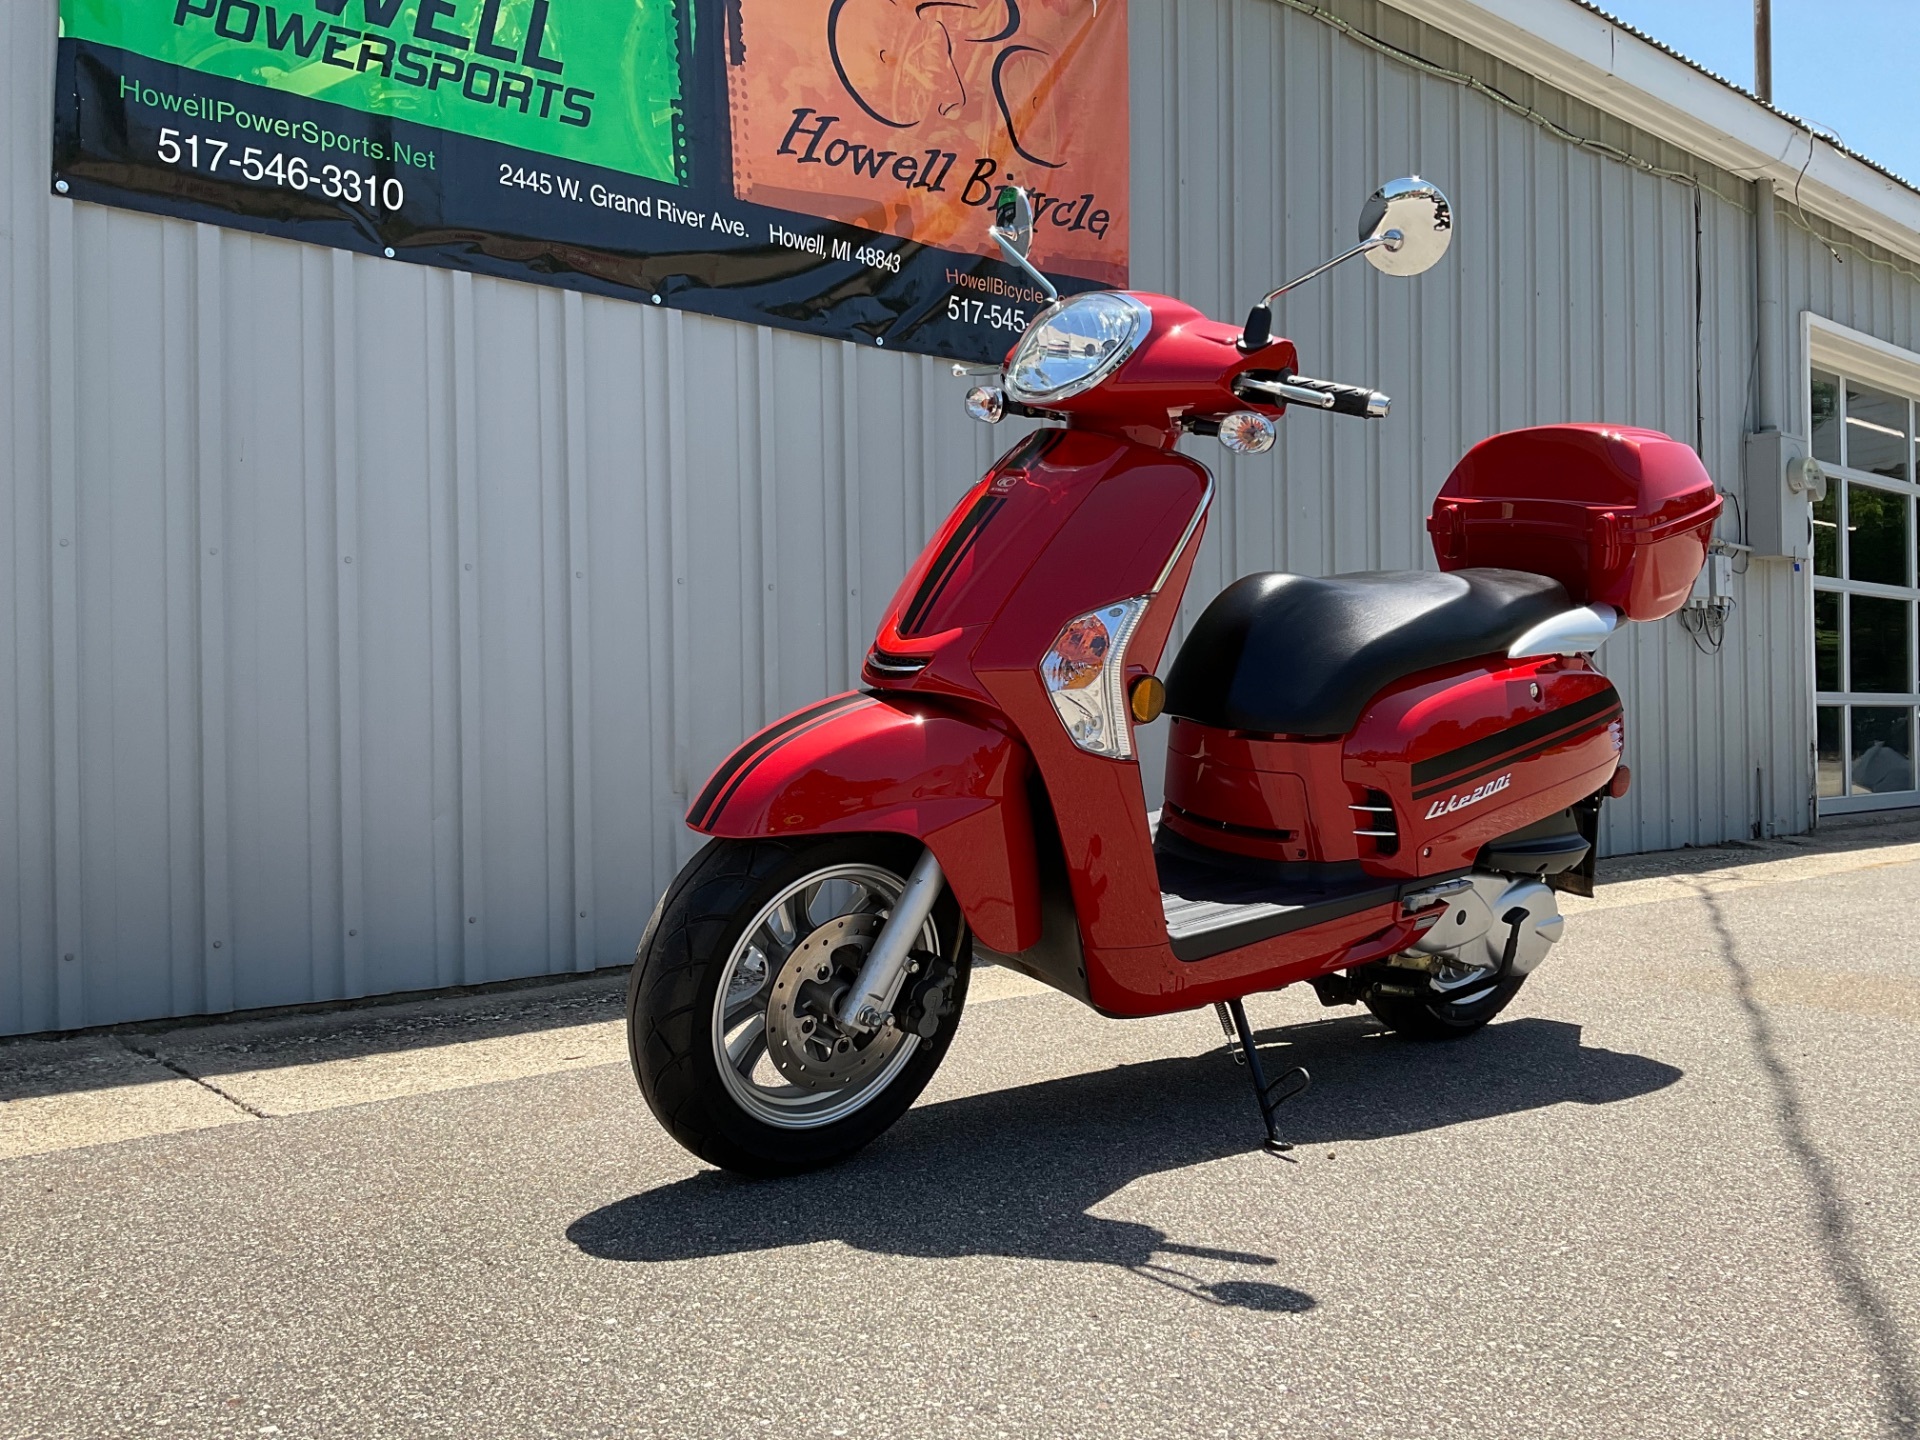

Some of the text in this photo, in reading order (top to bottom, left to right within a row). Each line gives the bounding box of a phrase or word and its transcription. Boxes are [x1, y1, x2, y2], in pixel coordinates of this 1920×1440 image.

[173, 0, 595, 128] POWERSPORTS
[120, 75, 436, 170] HowellPowerSports.Net
[157, 127, 404, 211] 517-546-3310
[776, 107, 1110, 241] Howell Biycle
[499, 163, 901, 274] 2445 W. Grand River Ave. Howell, MI 48843
